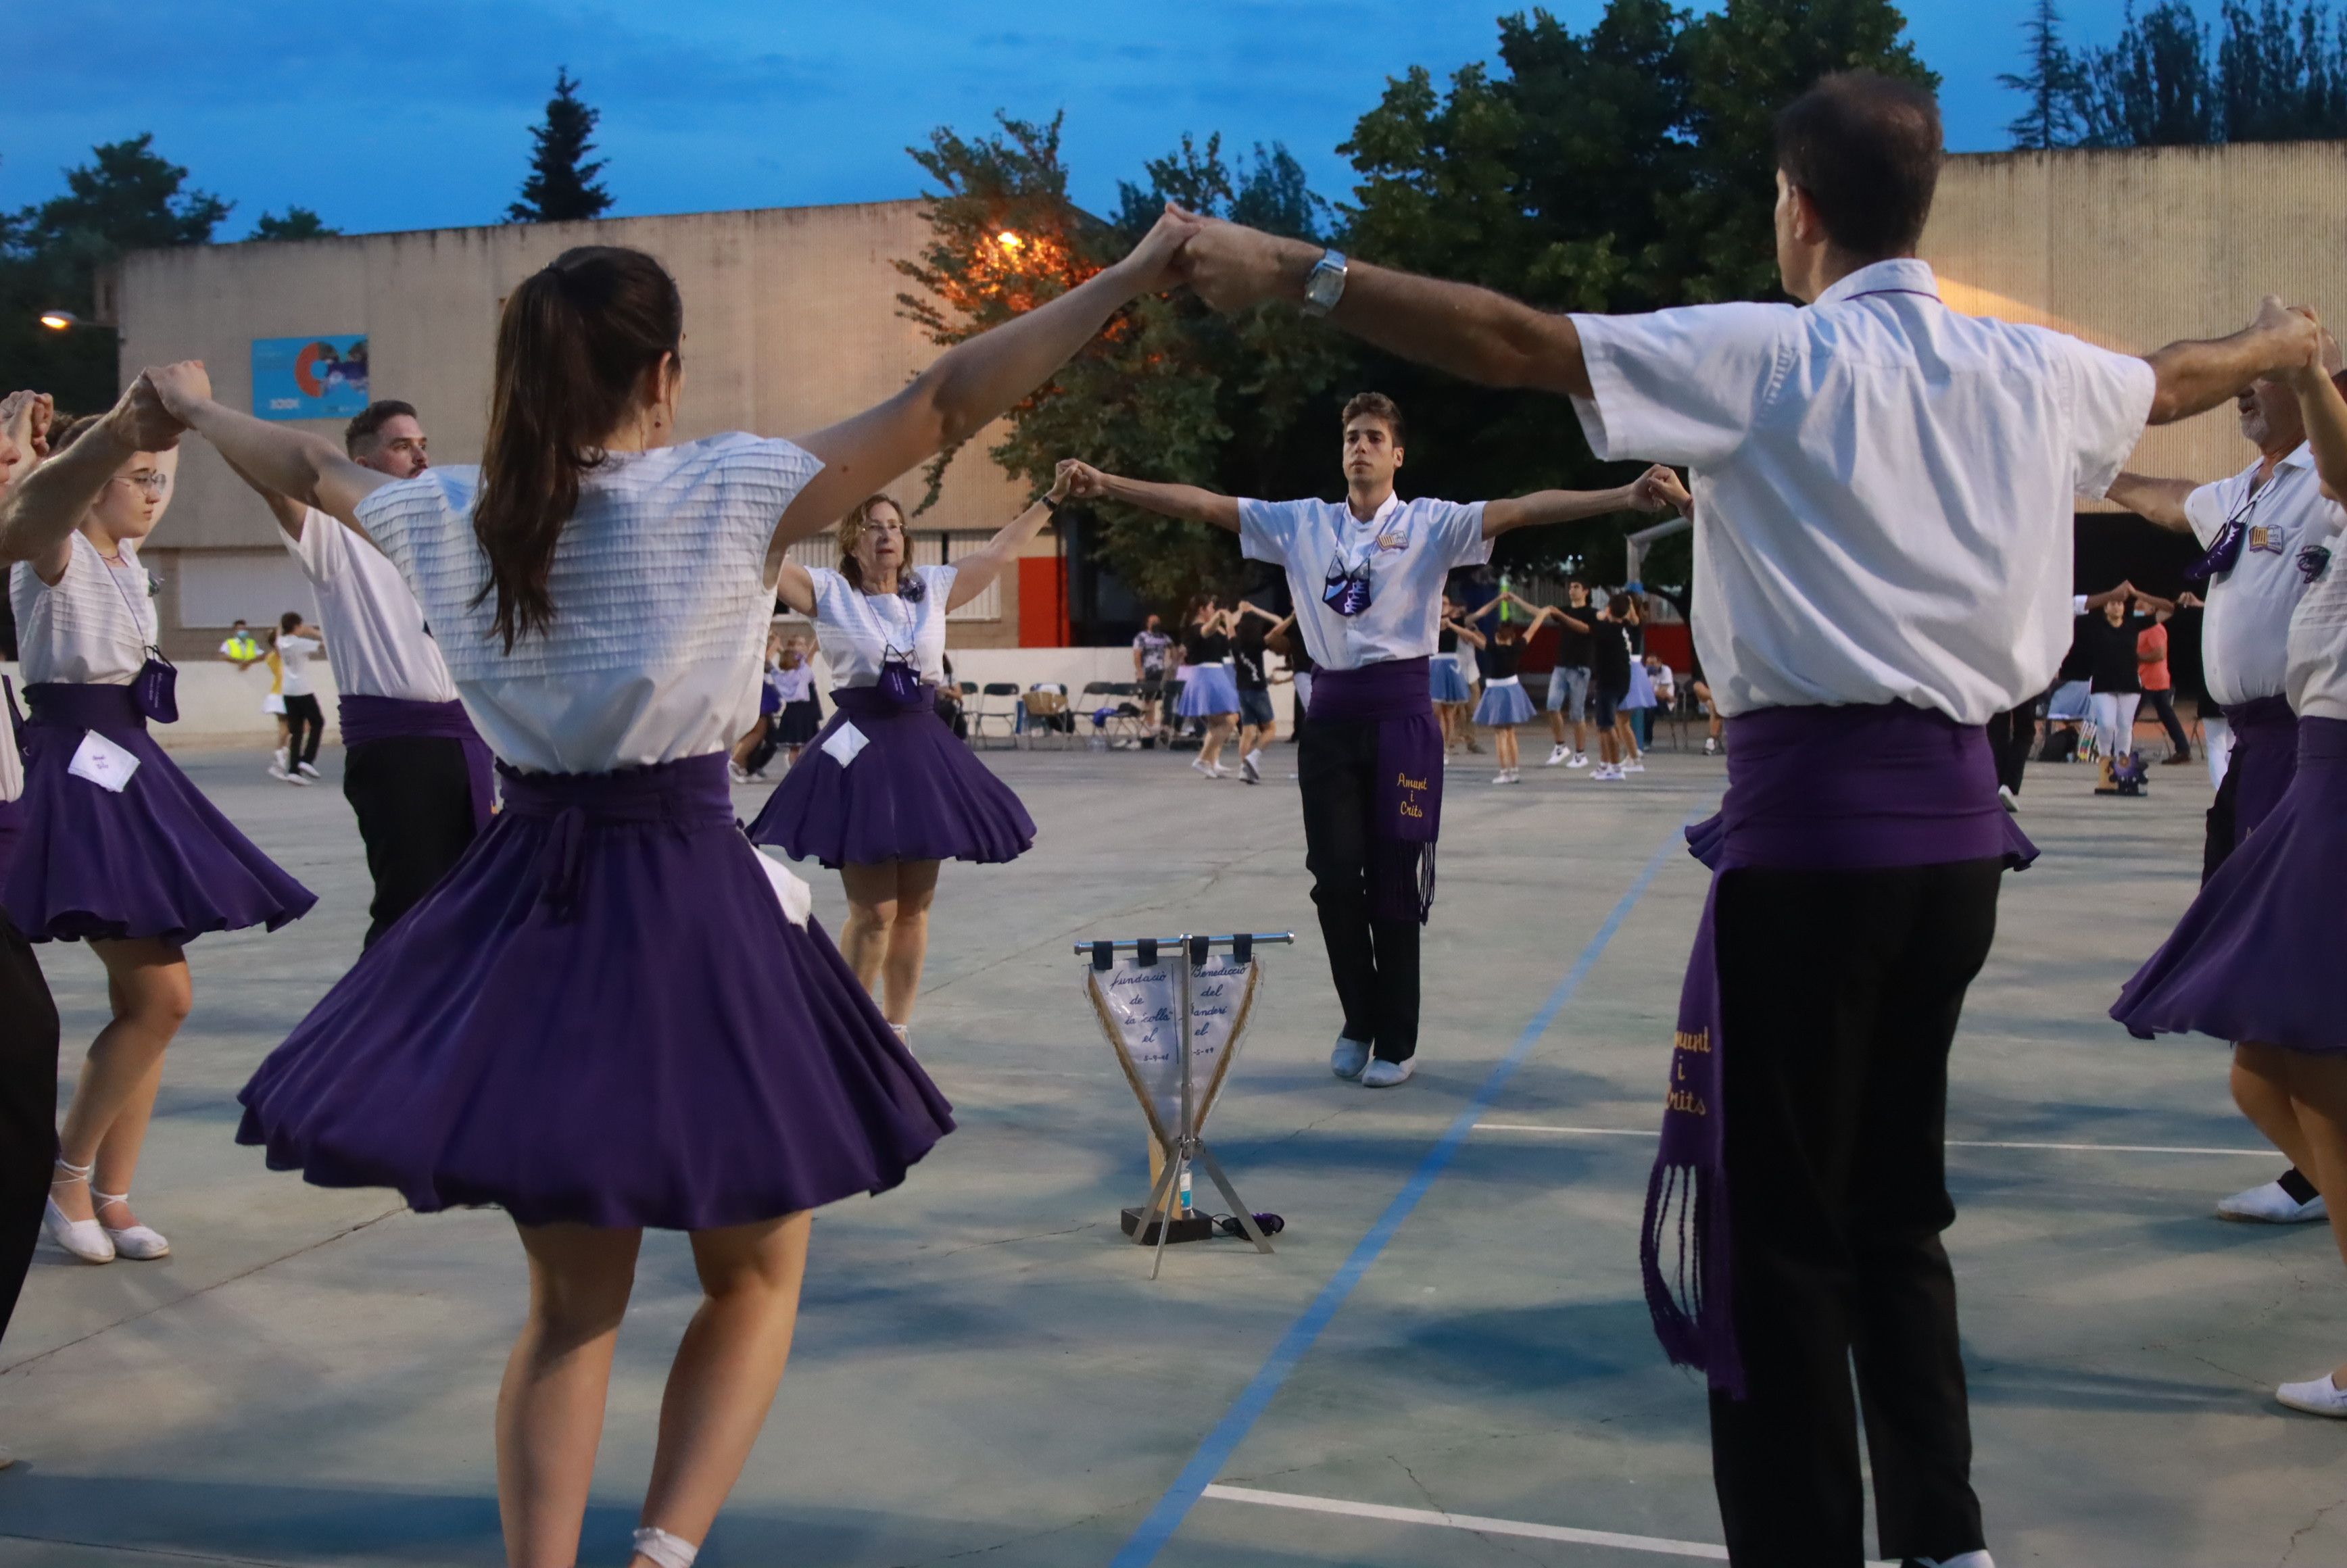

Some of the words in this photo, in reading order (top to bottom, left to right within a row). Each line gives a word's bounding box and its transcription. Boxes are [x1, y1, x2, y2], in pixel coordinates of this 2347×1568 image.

[1410, 790, 1415, 802] i
[1400, 801, 1423, 818] Crits
[1201, 983, 1224, 996] del
[1129, 994, 1144, 1004] de
[1124, 1011, 1136, 1025] la
[1142, 1027, 1158, 1043] el
[1194, 1021, 1209, 1036] el
[1677, 1055, 1686, 1080] i
[1665, 1081, 1707, 1115] rits
